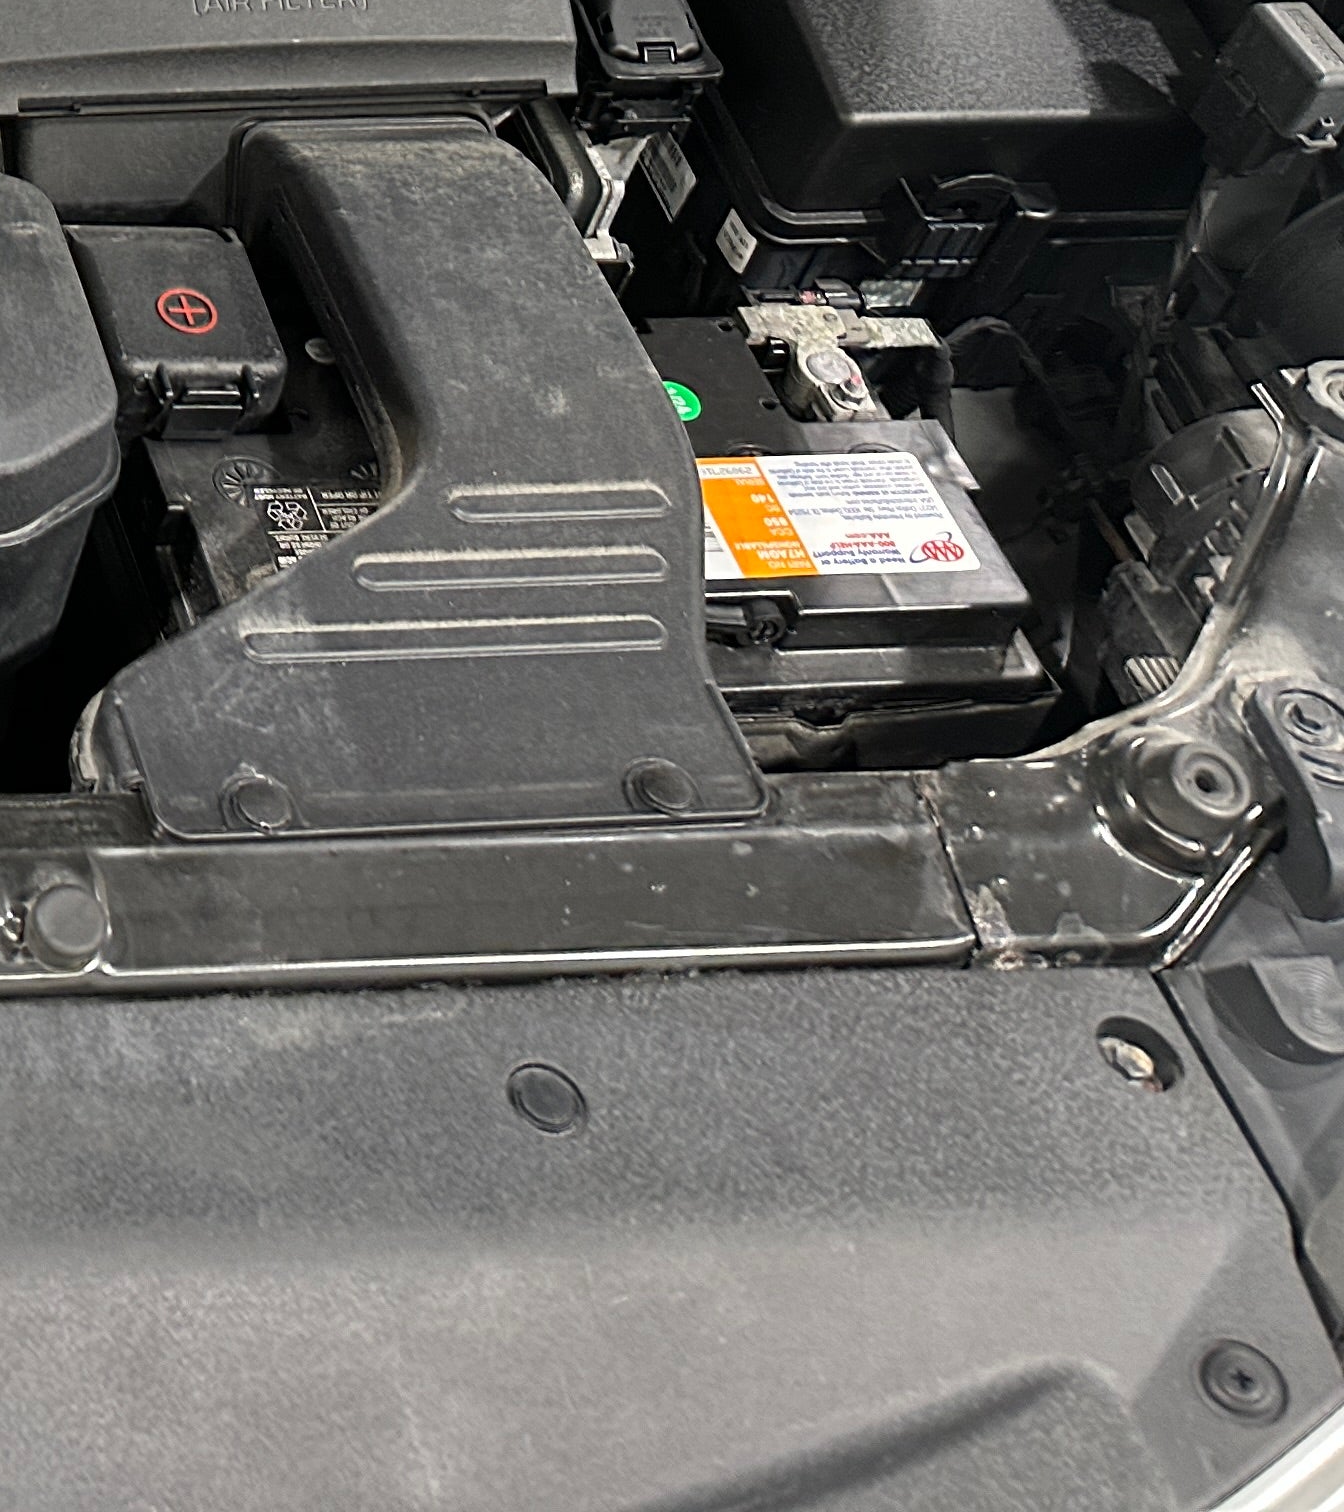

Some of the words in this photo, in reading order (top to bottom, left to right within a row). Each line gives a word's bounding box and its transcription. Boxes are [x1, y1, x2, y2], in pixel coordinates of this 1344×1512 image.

[750, 493, 774, 504] 140
[812, 548, 856, 558] Support?
[857, 548, 901, 557] Warranty
[922, 540, 964, 562] AAA
[834, 557, 868, 565] Battery
[880, 557, 906, 565] Need
